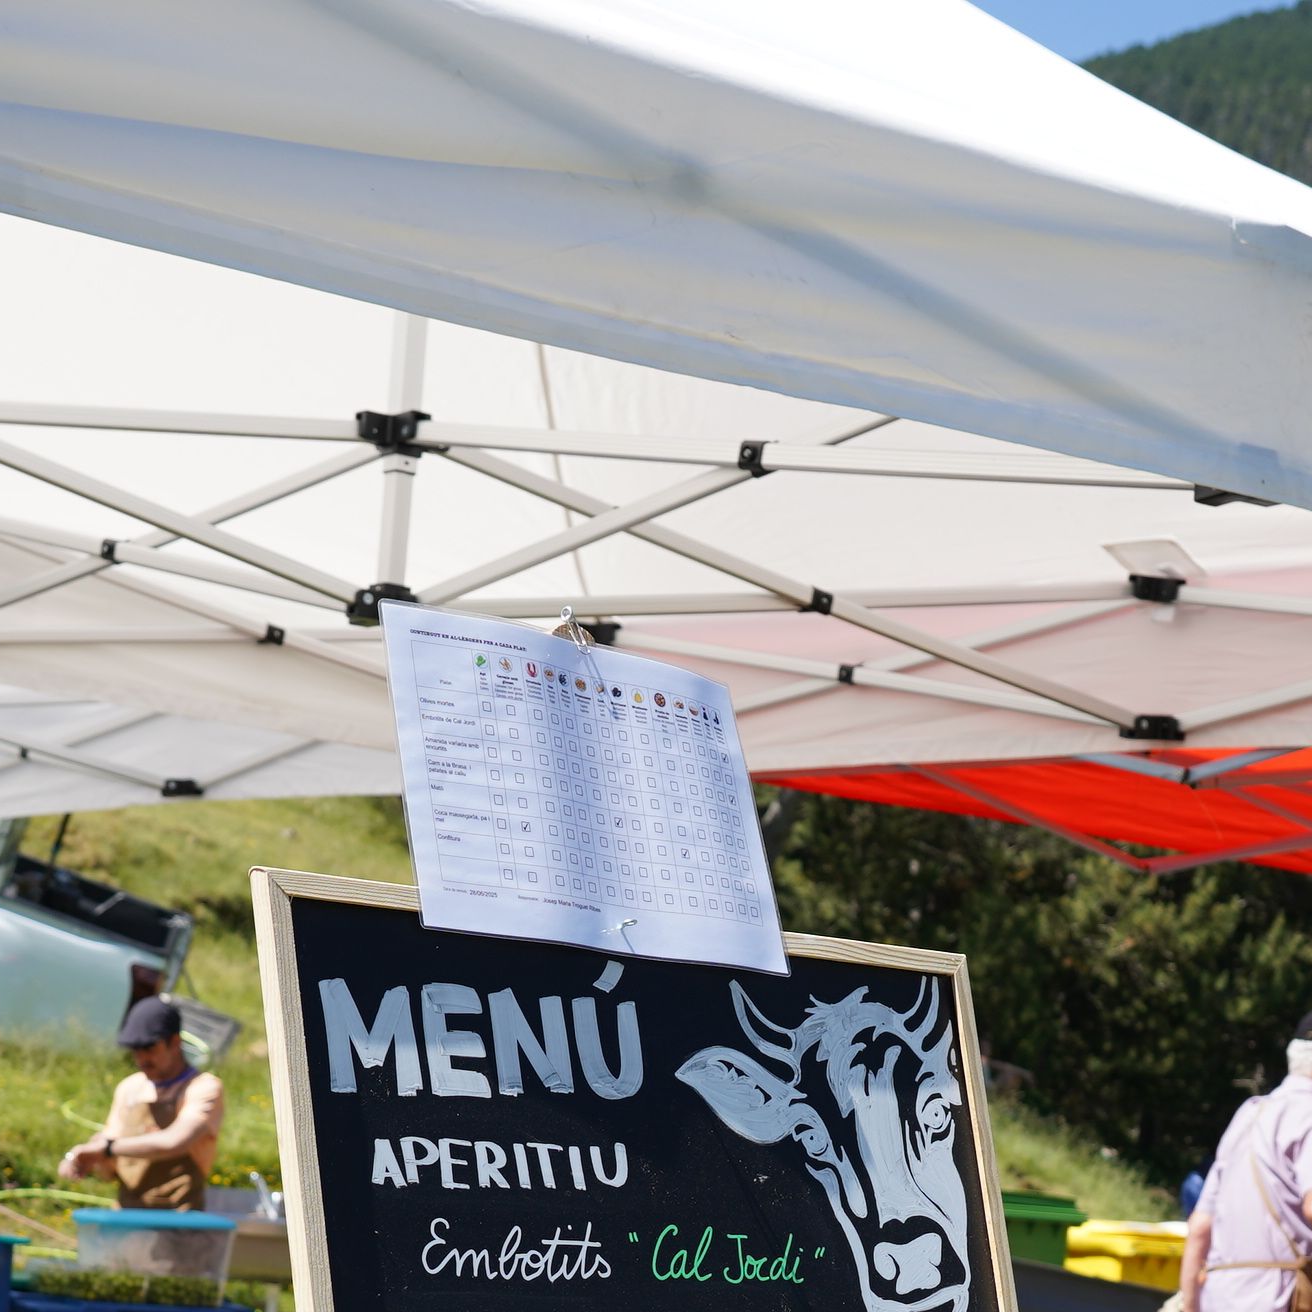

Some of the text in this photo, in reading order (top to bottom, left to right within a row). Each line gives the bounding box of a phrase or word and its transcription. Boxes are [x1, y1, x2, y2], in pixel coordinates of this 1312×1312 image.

[318, 960, 644, 1100] MENÚ
[371, 1135, 629, 1191] APERITIU
[421, 1217, 612, 1284] Embotits
